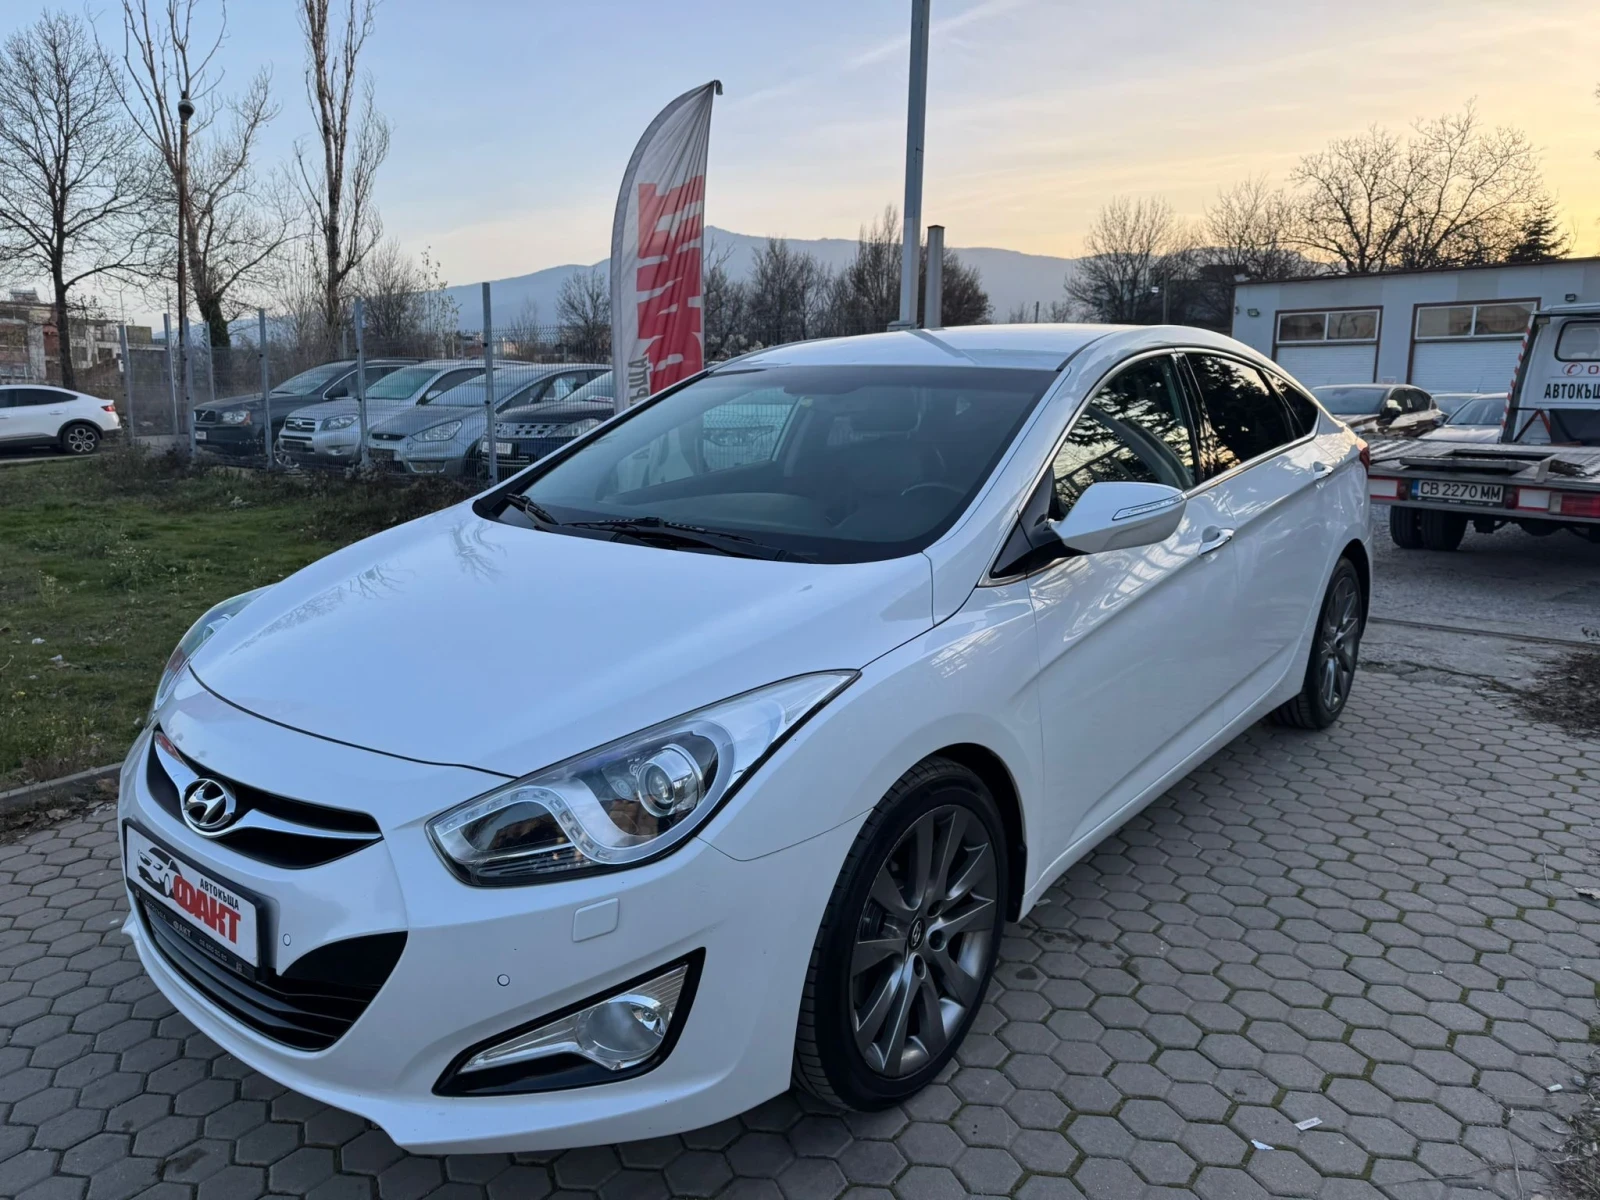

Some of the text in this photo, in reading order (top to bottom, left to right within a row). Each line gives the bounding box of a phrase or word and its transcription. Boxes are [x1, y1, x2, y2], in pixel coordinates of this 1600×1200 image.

[628, 356, 653, 407] ЪЩА
[1442, 483, 1478, 499] 2270
[1480, 485, 1502, 501] MM
[172, 874, 241, 945] ФАКТ
[199, 878, 240, 911] АВТОКЪЩА
